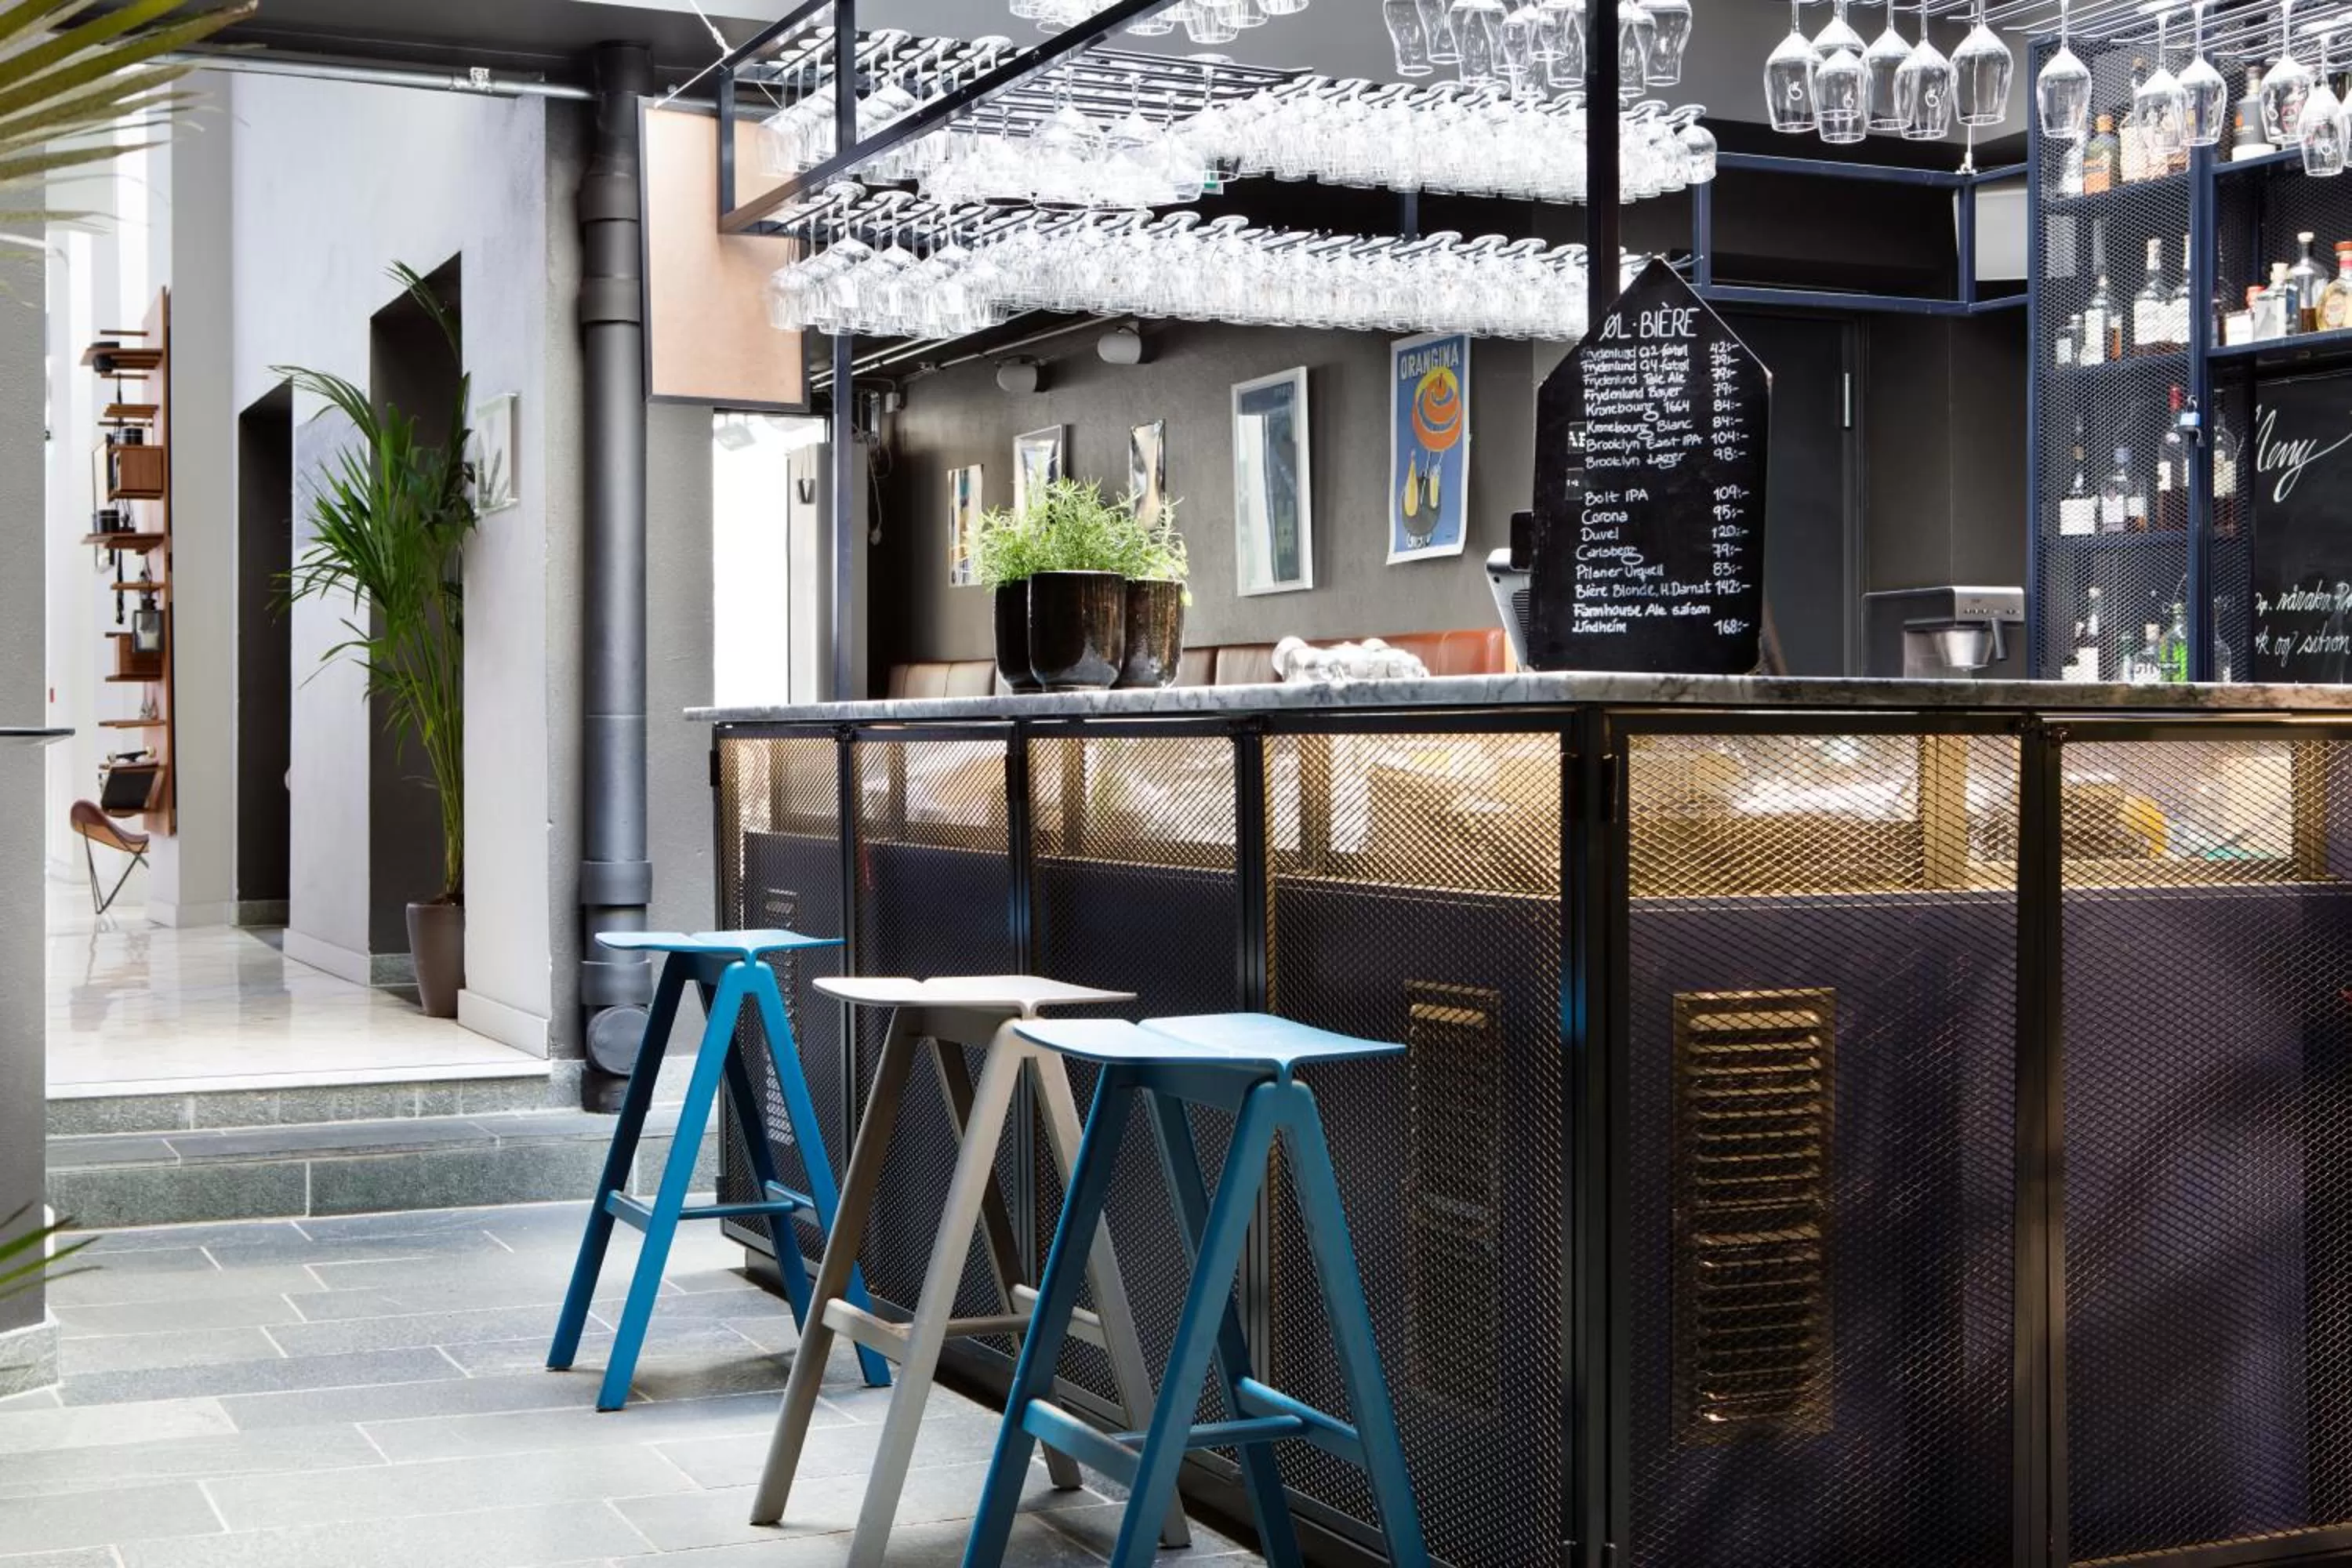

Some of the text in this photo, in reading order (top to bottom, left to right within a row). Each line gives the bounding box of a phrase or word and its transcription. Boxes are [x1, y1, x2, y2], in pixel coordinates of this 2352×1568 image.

[1639, 301, 1700, 338] BIÈRE
[1400, 341, 1459, 380] ORANGINA
[1667, 371, 1686, 384] Ale
[1663, 399, 1690, 414] 1664
[1656, 419, 1693, 433] Blanc
[1585, 437, 1640, 455] Brooklyn
[1646, 435, 1681, 450] East
[1682, 433, 1704, 447] IPA
[1584, 455, 1640, 470] Brooklyn
[1646, 452, 1686, 470] Lager
[1584, 490, 1621, 507] Bolt
[1625, 488, 1649, 503] IPA
[1581, 509, 1628, 525] Corona
[1580, 526, 1619, 542] Duvel
[1575, 544, 1644, 565] Carlsberg
[1575, 563, 1623, 580] Pilsner
[1624, 563, 1664, 583] Urquell
[1574, 583, 1608, 600] Bière
[1572, 601, 1711, 618] Farmhouse Ale saison
[1572, 618, 1627, 633] Lindheim
